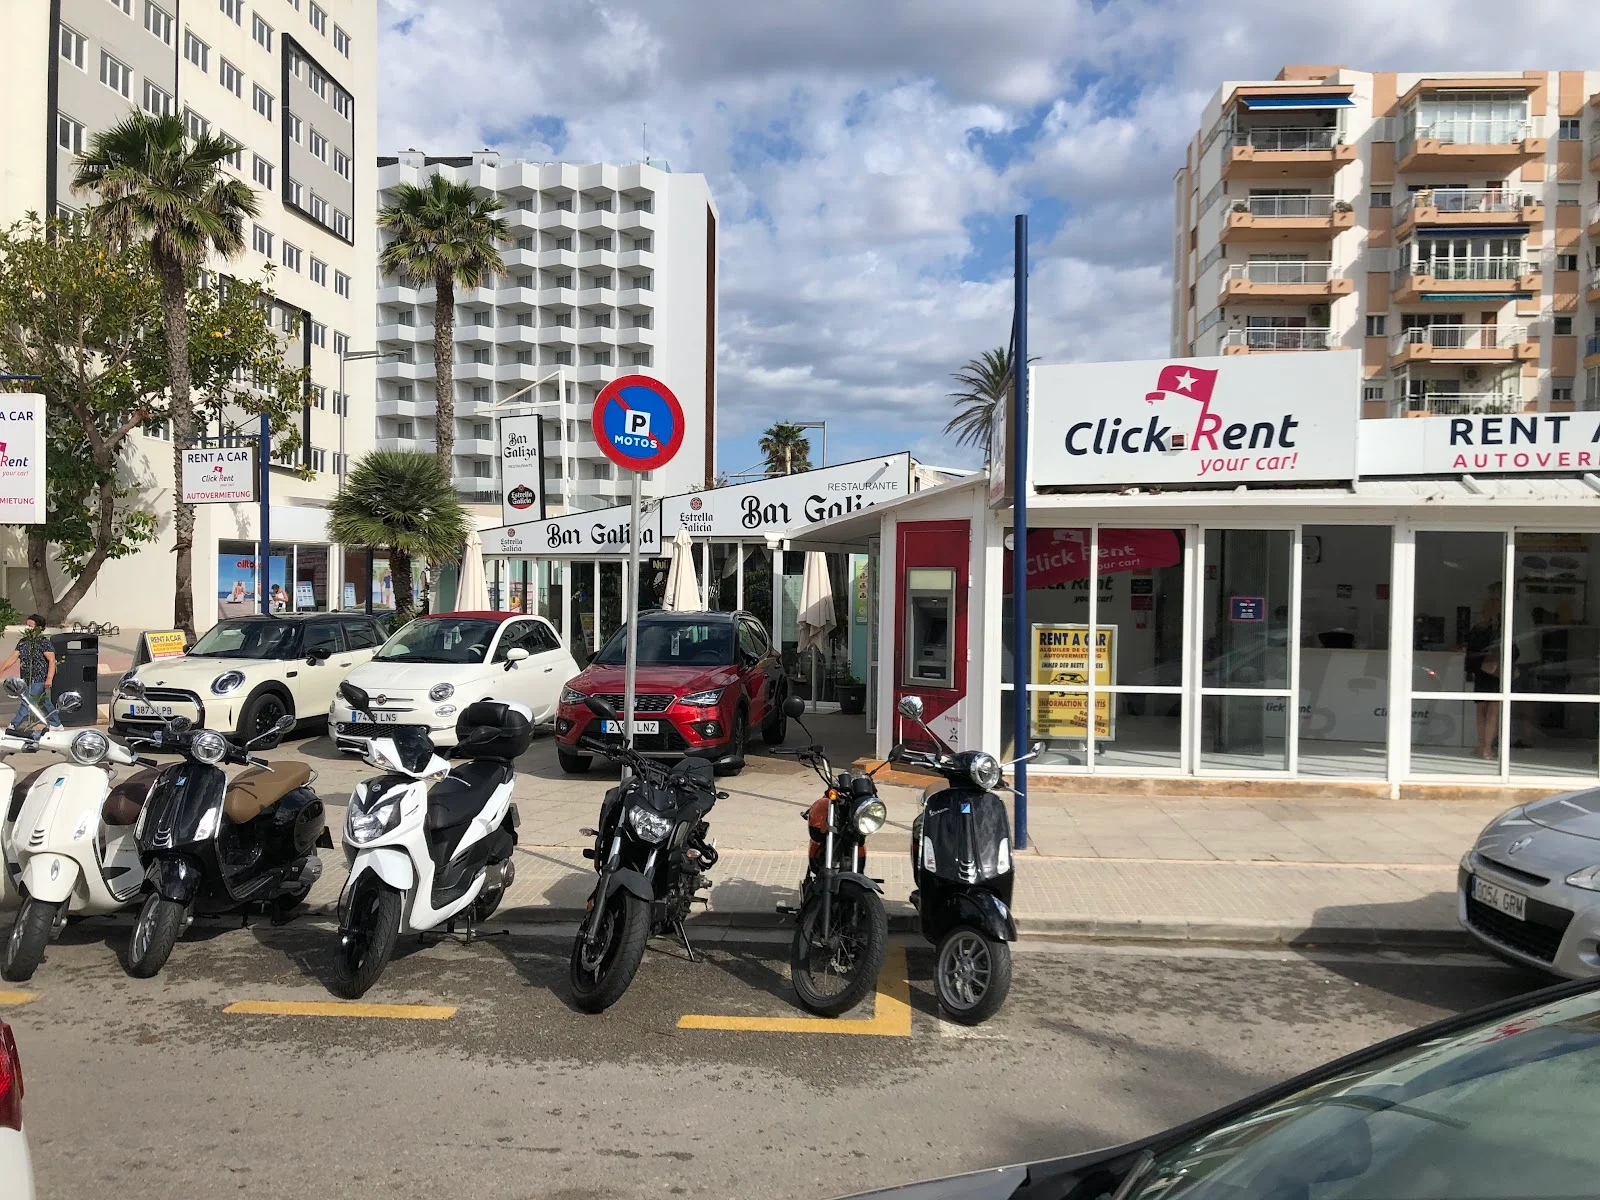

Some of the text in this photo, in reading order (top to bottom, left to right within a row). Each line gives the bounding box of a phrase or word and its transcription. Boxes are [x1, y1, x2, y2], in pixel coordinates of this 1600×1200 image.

[9, 411, 34, 421] CAR
[632, 414, 647, 432] P
[1065, 413, 1299, 455] Click Rent
[1450, 416, 1571, 446] RENT
[508, 432, 528, 447] Bar
[614, 435, 658, 449] MOTOS
[187, 451, 248, 463] RENT A CAR
[504, 446, 537, 460] Galiza
[0, 455, 29, 467] Rent
[1197, 452, 1298, 476] your car!
[1453, 452, 1600, 468] AUTOVER
[219, 474, 234, 482] Rent
[827, 481, 898, 491] RESTAURANTE
[186, 490, 251, 500] AUTOVERMIETUNG
[512, 497, 532, 505] Galicia
[679, 512, 714, 522] Estrella
[741, 495, 792, 529] Bar
[547, 523, 654, 548] Bar Galia
[1098, 562, 1116, 570] our
[1040, 632, 1068, 646] RENT
[1072, 633, 1080, 646] A
[380, 714, 397, 722] LNS
[637, 722, 656, 732] LNZ
